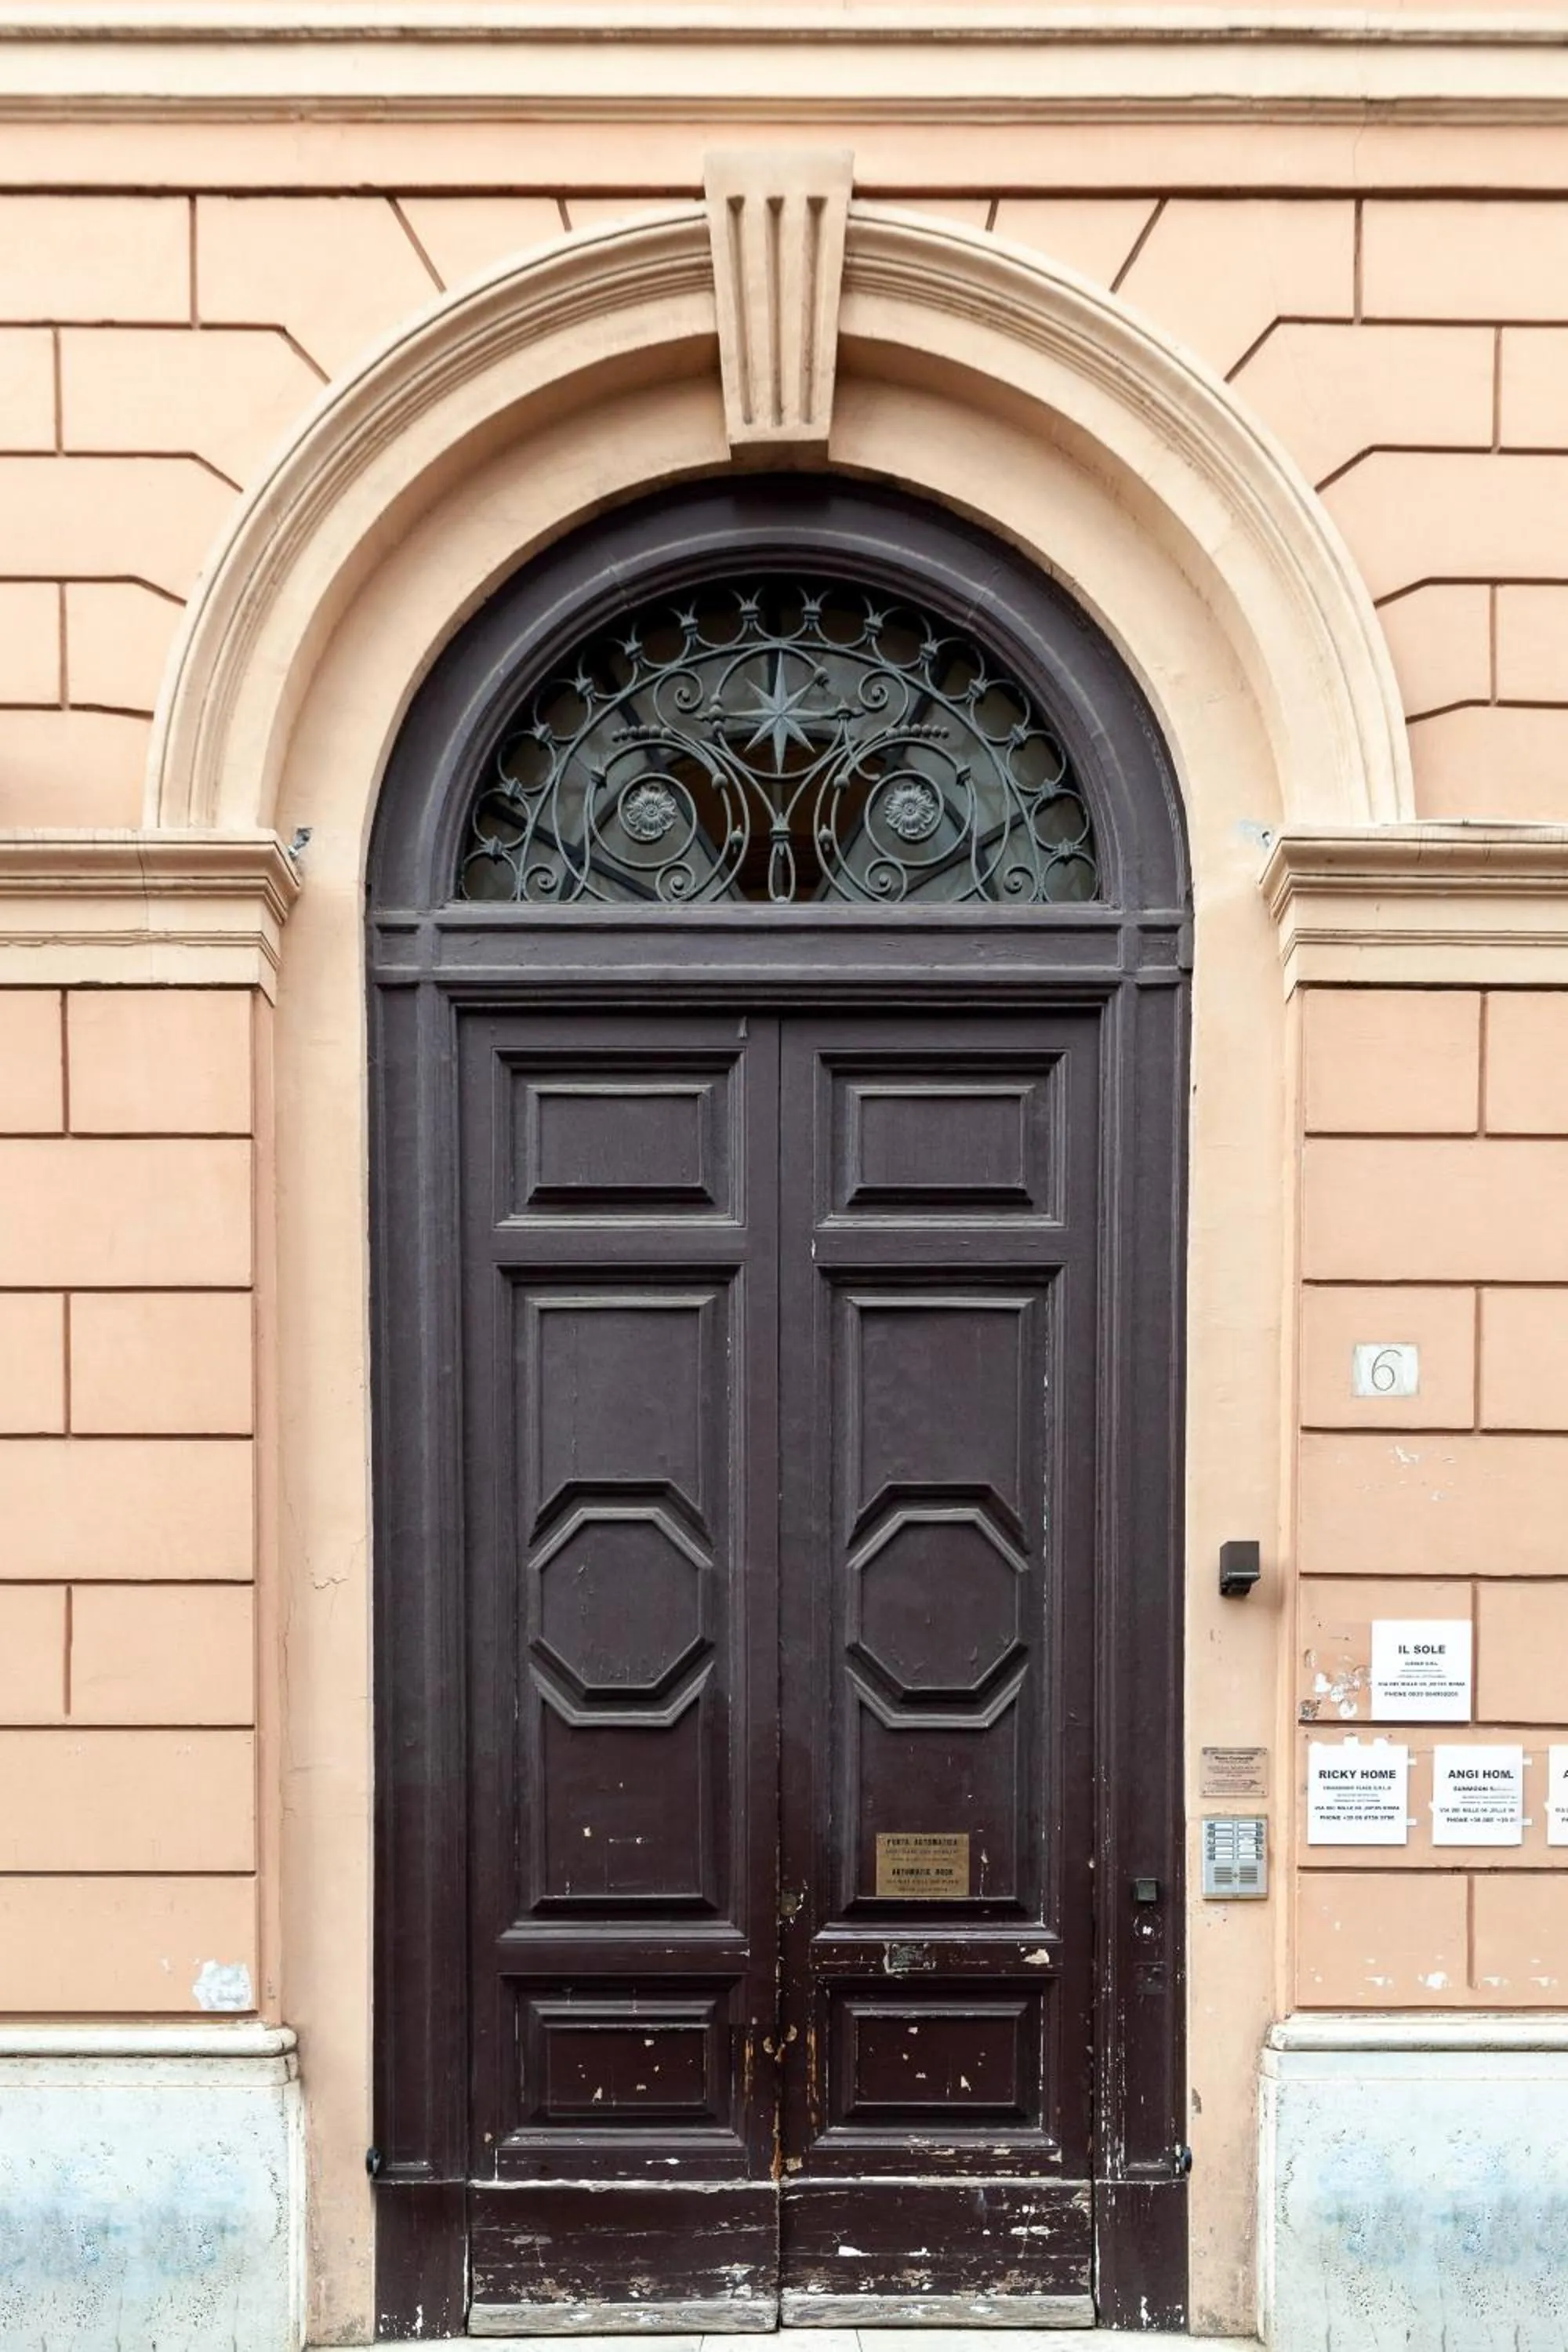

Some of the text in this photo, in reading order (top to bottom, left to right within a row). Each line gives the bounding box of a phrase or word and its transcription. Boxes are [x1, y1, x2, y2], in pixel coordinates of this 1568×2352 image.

[1371, 1349, 1403, 1392] 6
[1398, 1644, 1446, 1654] IL SOLE
[1318, 1769, 1396, 1779] RICKY HOME
[1447, 1769, 1479, 1779] ANGI
